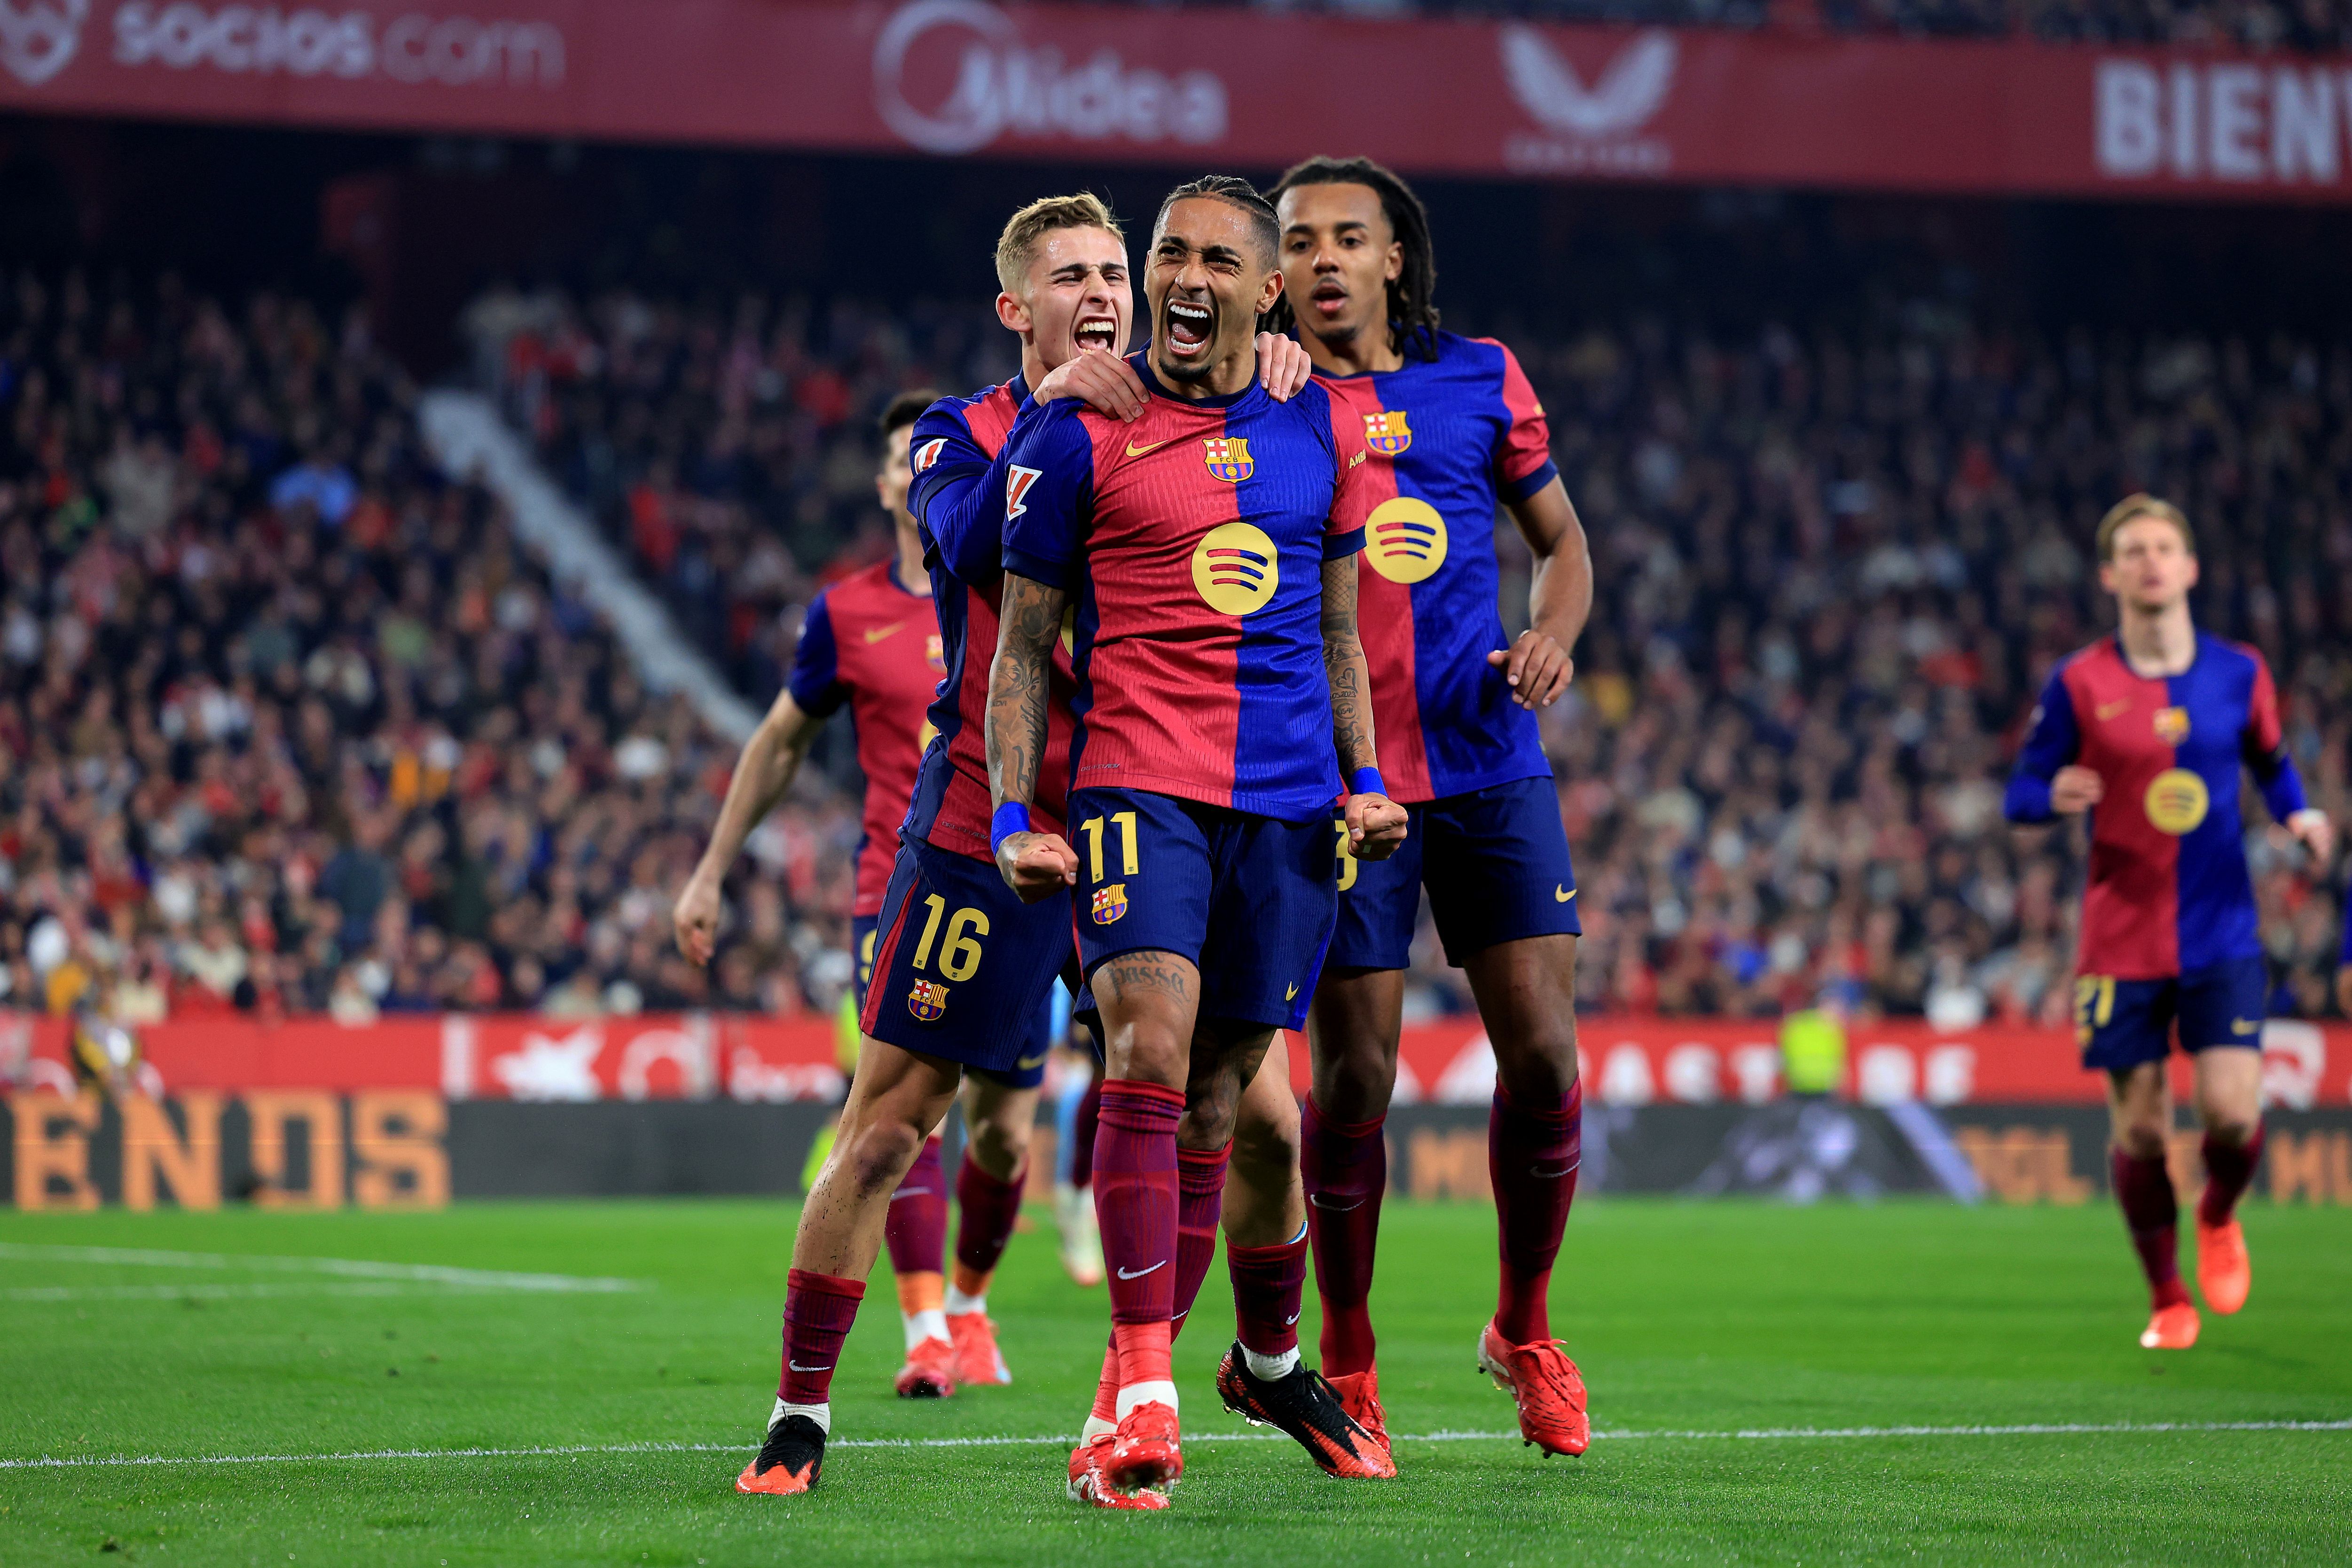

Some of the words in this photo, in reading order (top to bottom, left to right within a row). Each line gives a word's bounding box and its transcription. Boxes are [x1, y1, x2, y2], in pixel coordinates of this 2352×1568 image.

[2094, 57, 2352, 186] BIEN
[1080, 811, 1139, 884] 11
[912, 893, 989, 982] 16
[920, 996, 935, 1005] FCB
